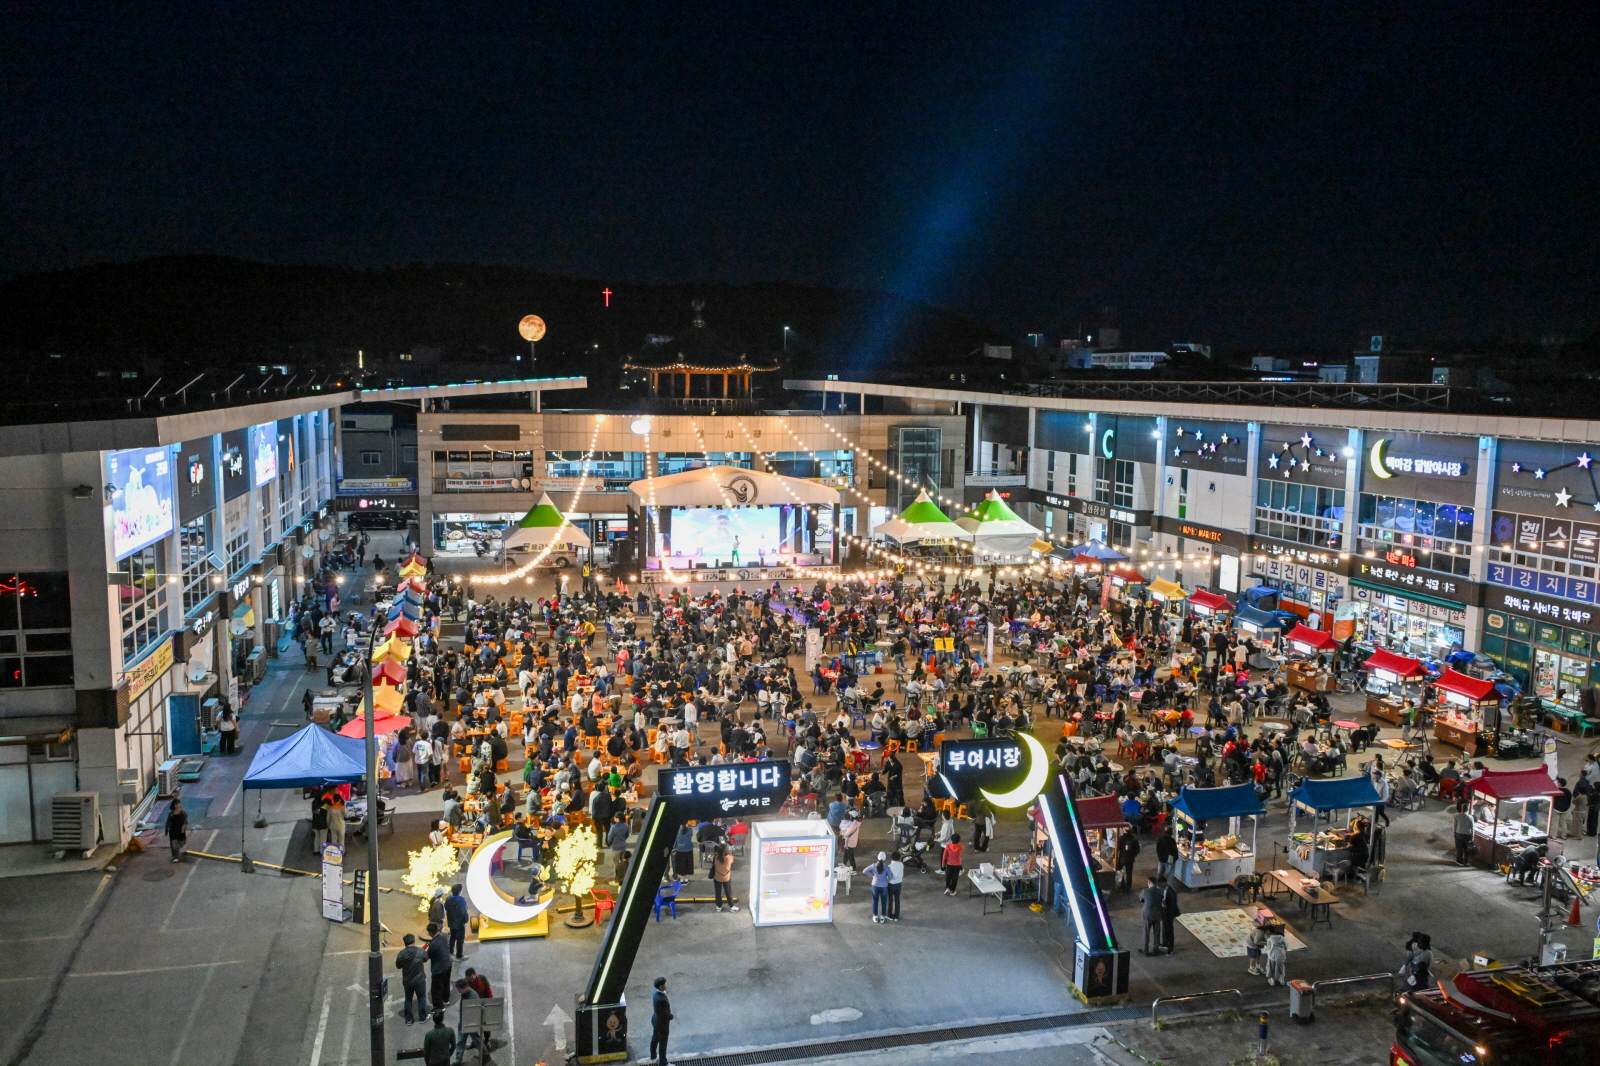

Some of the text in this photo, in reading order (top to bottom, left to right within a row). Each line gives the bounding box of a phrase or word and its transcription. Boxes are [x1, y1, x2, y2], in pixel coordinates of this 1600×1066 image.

[1102, 429, 1114, 459] C
[1414, 459, 1462, 477] 달밤야시장
[1087, 504, 1106, 517] 화장실
[1519, 520, 1598, 553] 헬스트
[1256, 558, 1326, 588] 마포건어물
[1370, 565, 1384, 578] 농산
[1384, 568, 1399, 581] 축산
[1400, 573, 1415, 585] 수산
[1493, 566, 1588, 599] 건강지킴
[947, 746, 1021, 771] 부여시장
[672, 766, 780, 795] 환영합니다
[738, 797, 771, 808] 부여군
